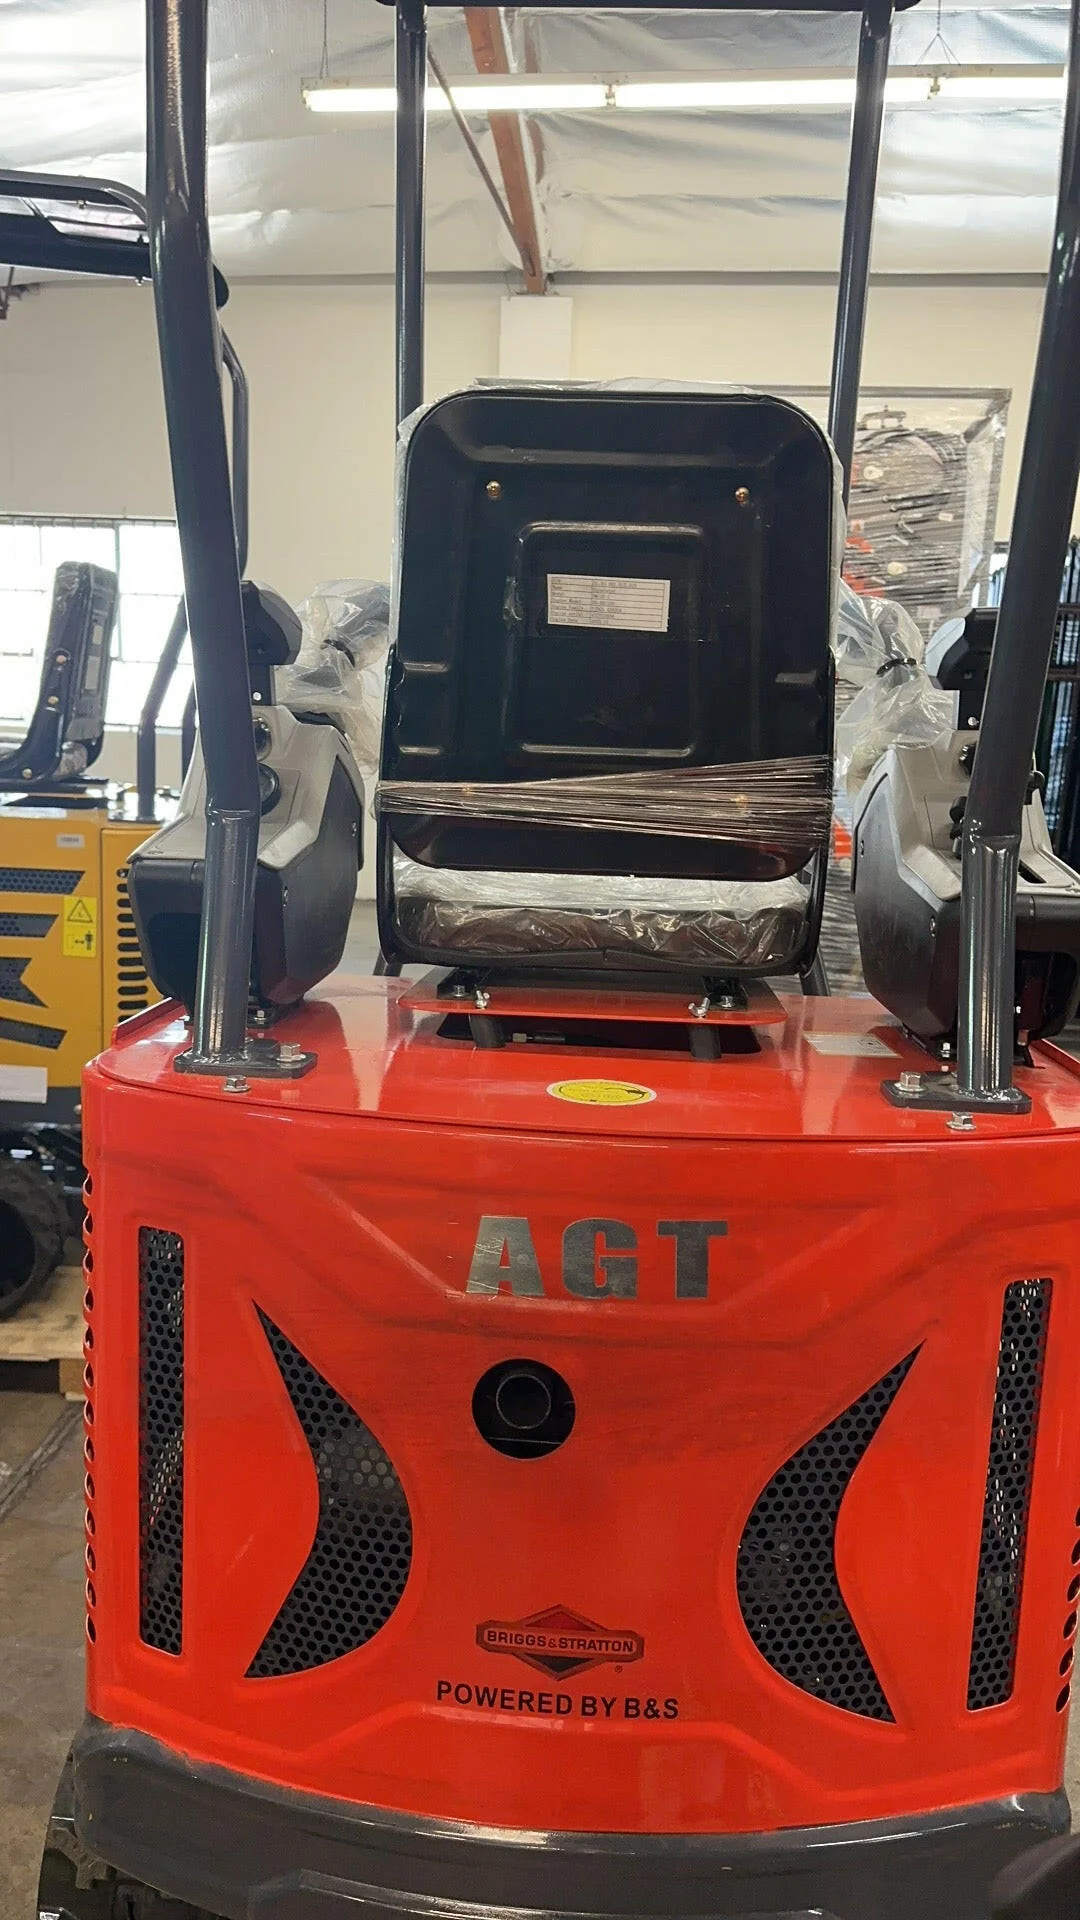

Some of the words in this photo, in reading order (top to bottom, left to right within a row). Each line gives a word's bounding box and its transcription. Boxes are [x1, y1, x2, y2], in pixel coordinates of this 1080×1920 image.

[466, 1215, 729, 1300] AGT
[437, 1680, 573, 1715] POWERED
[581, 1696, 617, 1717] BY
[624, 1697, 679, 1719] B&S
